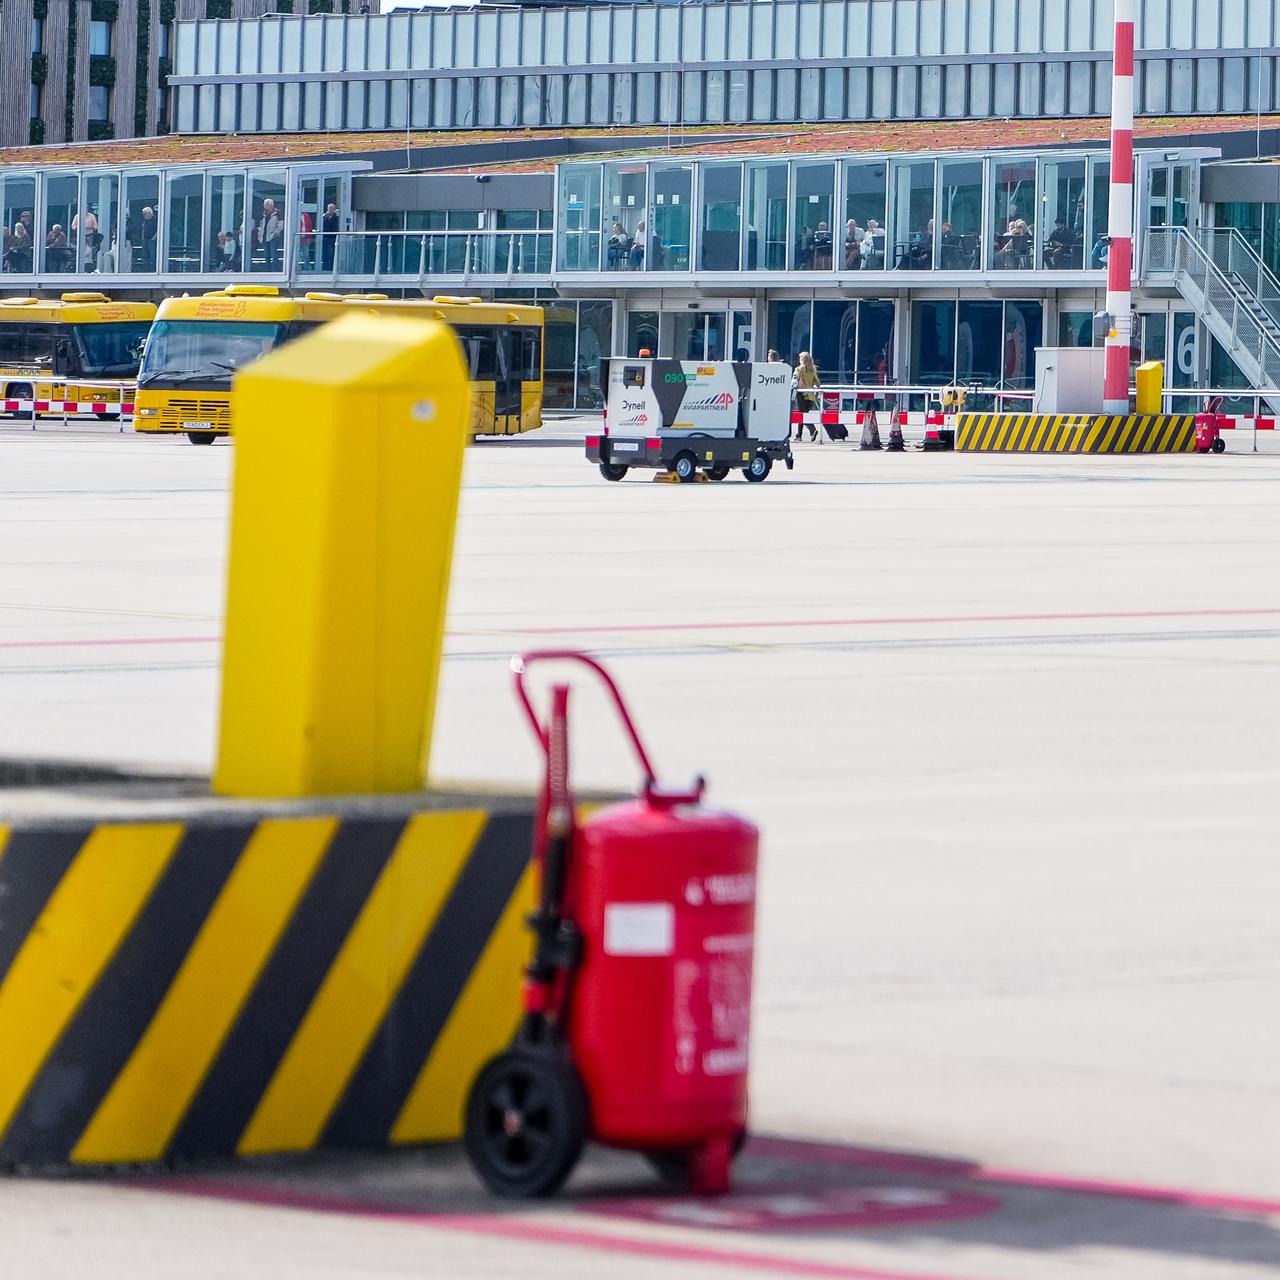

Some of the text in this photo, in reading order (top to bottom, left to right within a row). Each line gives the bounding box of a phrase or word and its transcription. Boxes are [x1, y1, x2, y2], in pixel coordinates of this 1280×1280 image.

[1178, 326, 1195, 374] 6
[758, 374, 786, 386] Dynell
[622, 400, 646, 412] Dynell
